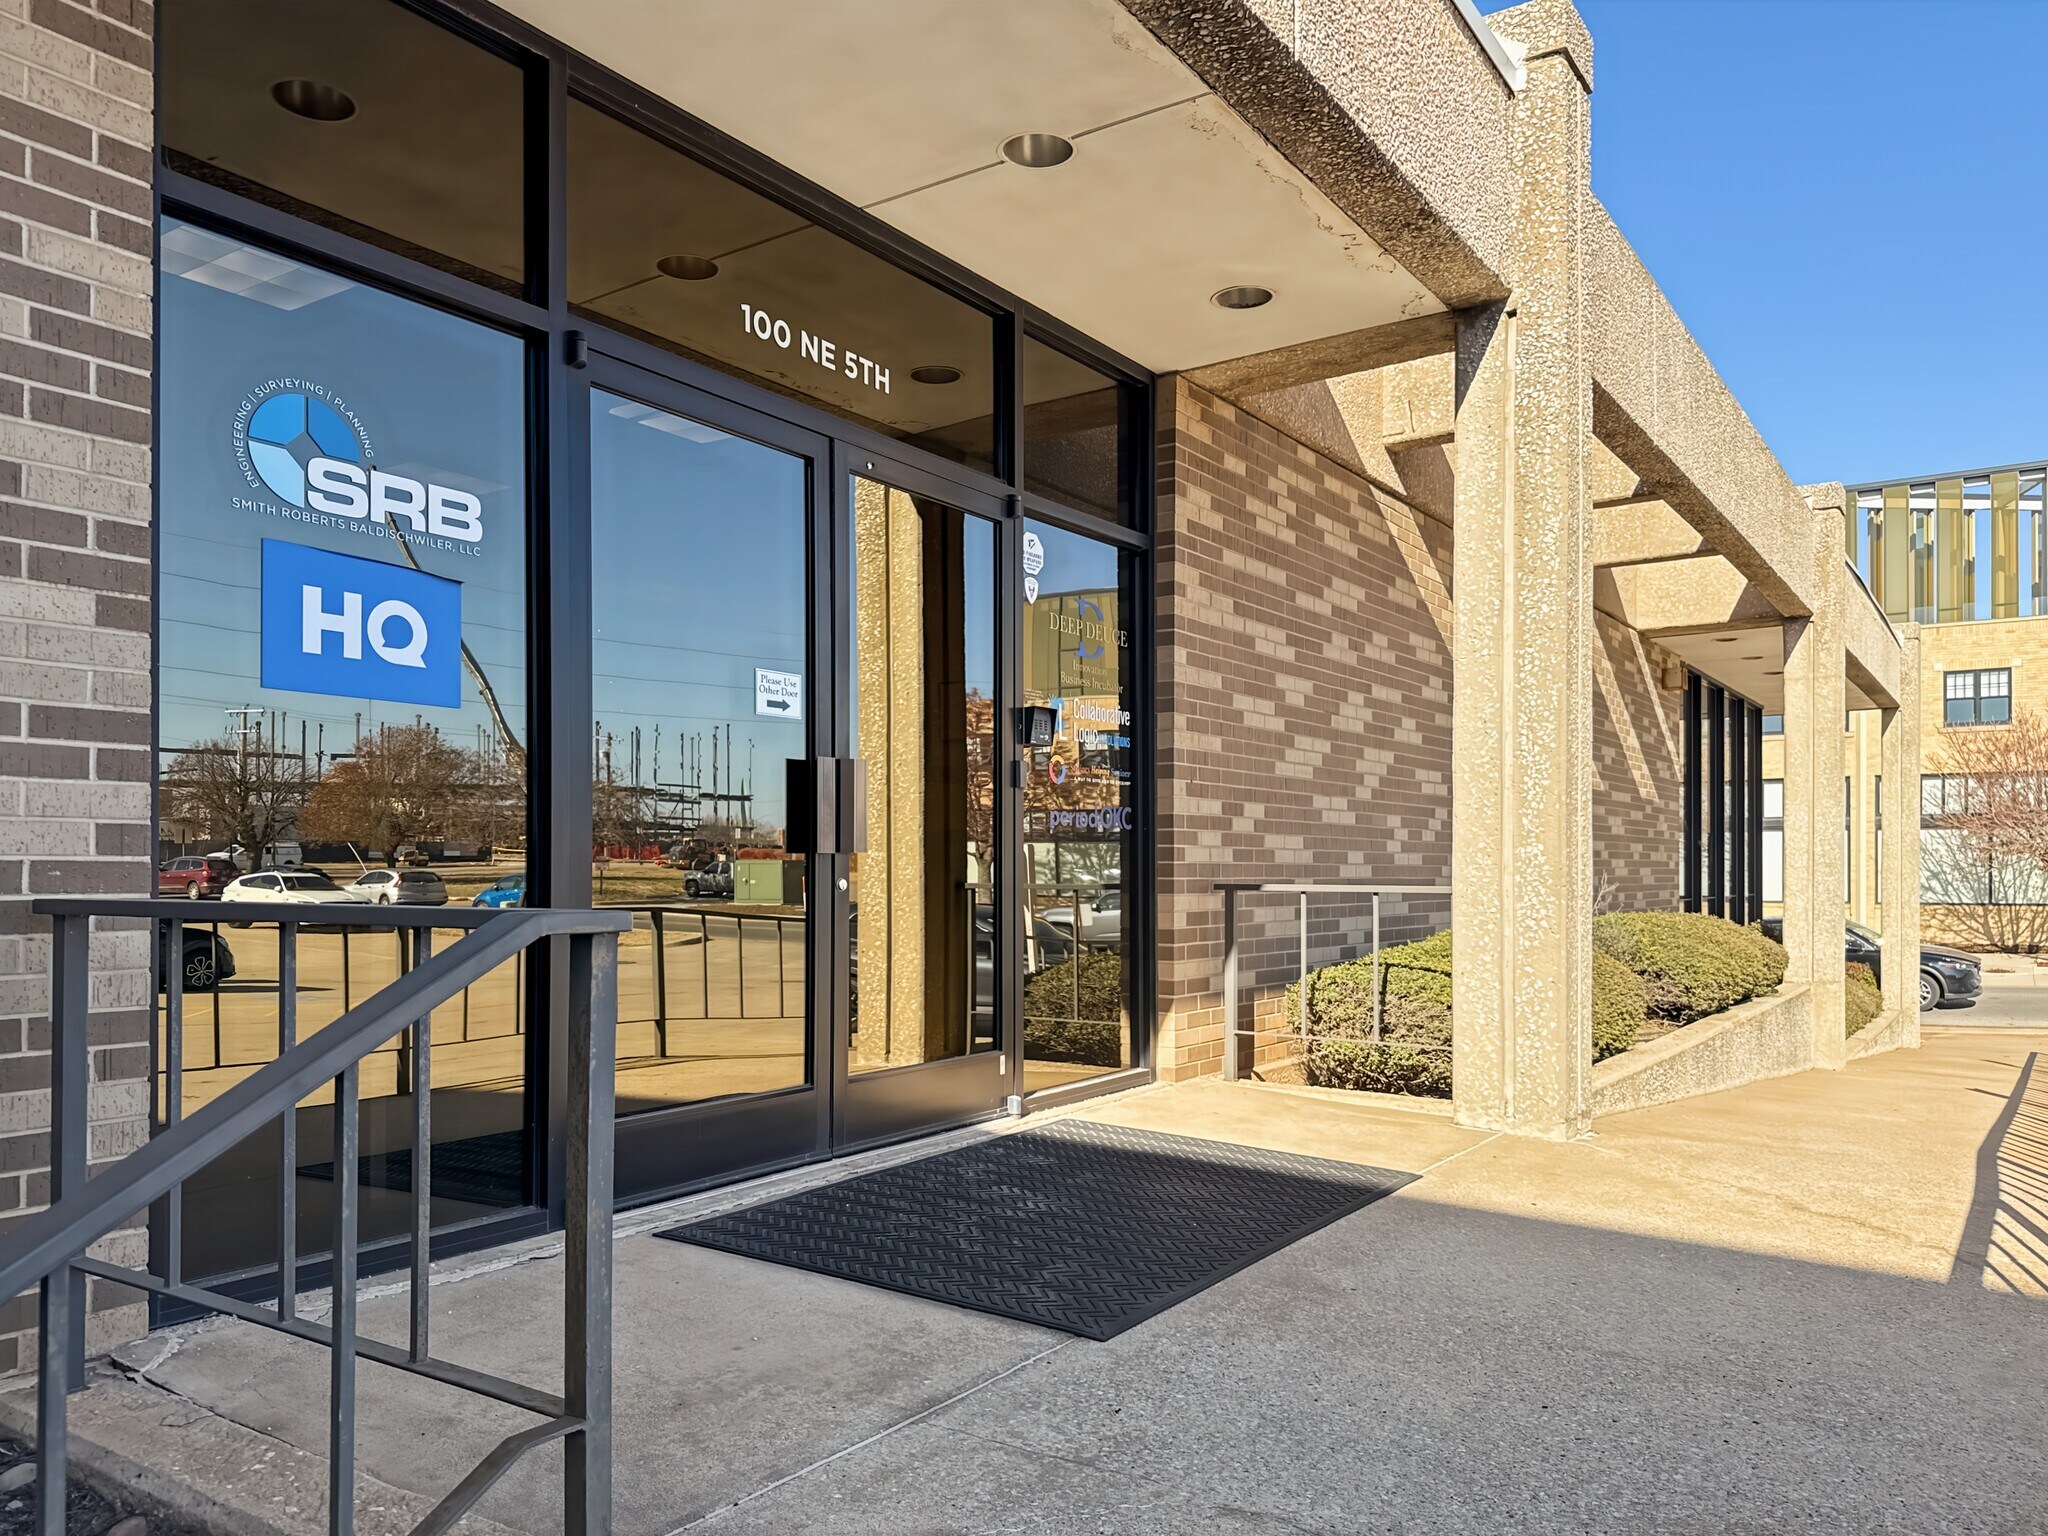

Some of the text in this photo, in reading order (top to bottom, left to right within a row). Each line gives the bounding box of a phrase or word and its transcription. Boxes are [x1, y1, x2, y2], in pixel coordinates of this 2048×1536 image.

[740, 304, 890, 394] 100 NE 5TH
[233, 401, 260, 488] ENGINEERING
[254, 378, 325, 397] SURVEYING
[333, 397, 374, 458] PLANNING
[307, 456, 483, 543] SRB
[231, 497, 481, 557] SMITH ROBERTS BALDISCHWILER, LLC
[302, 584, 428, 669] HQ
[1050, 612, 1128, 648] DEEP DEUCE
[760, 674, 797, 687] Please Use
[1060, 671, 1124, 694] Business Incubator
[1073, 659, 1108, 677] Innovation
[759, 684, 798, 697] Other Door
[1073, 698, 1130, 726] Collaborative
[1074, 721, 1130, 748] Logic OLUTIONS
